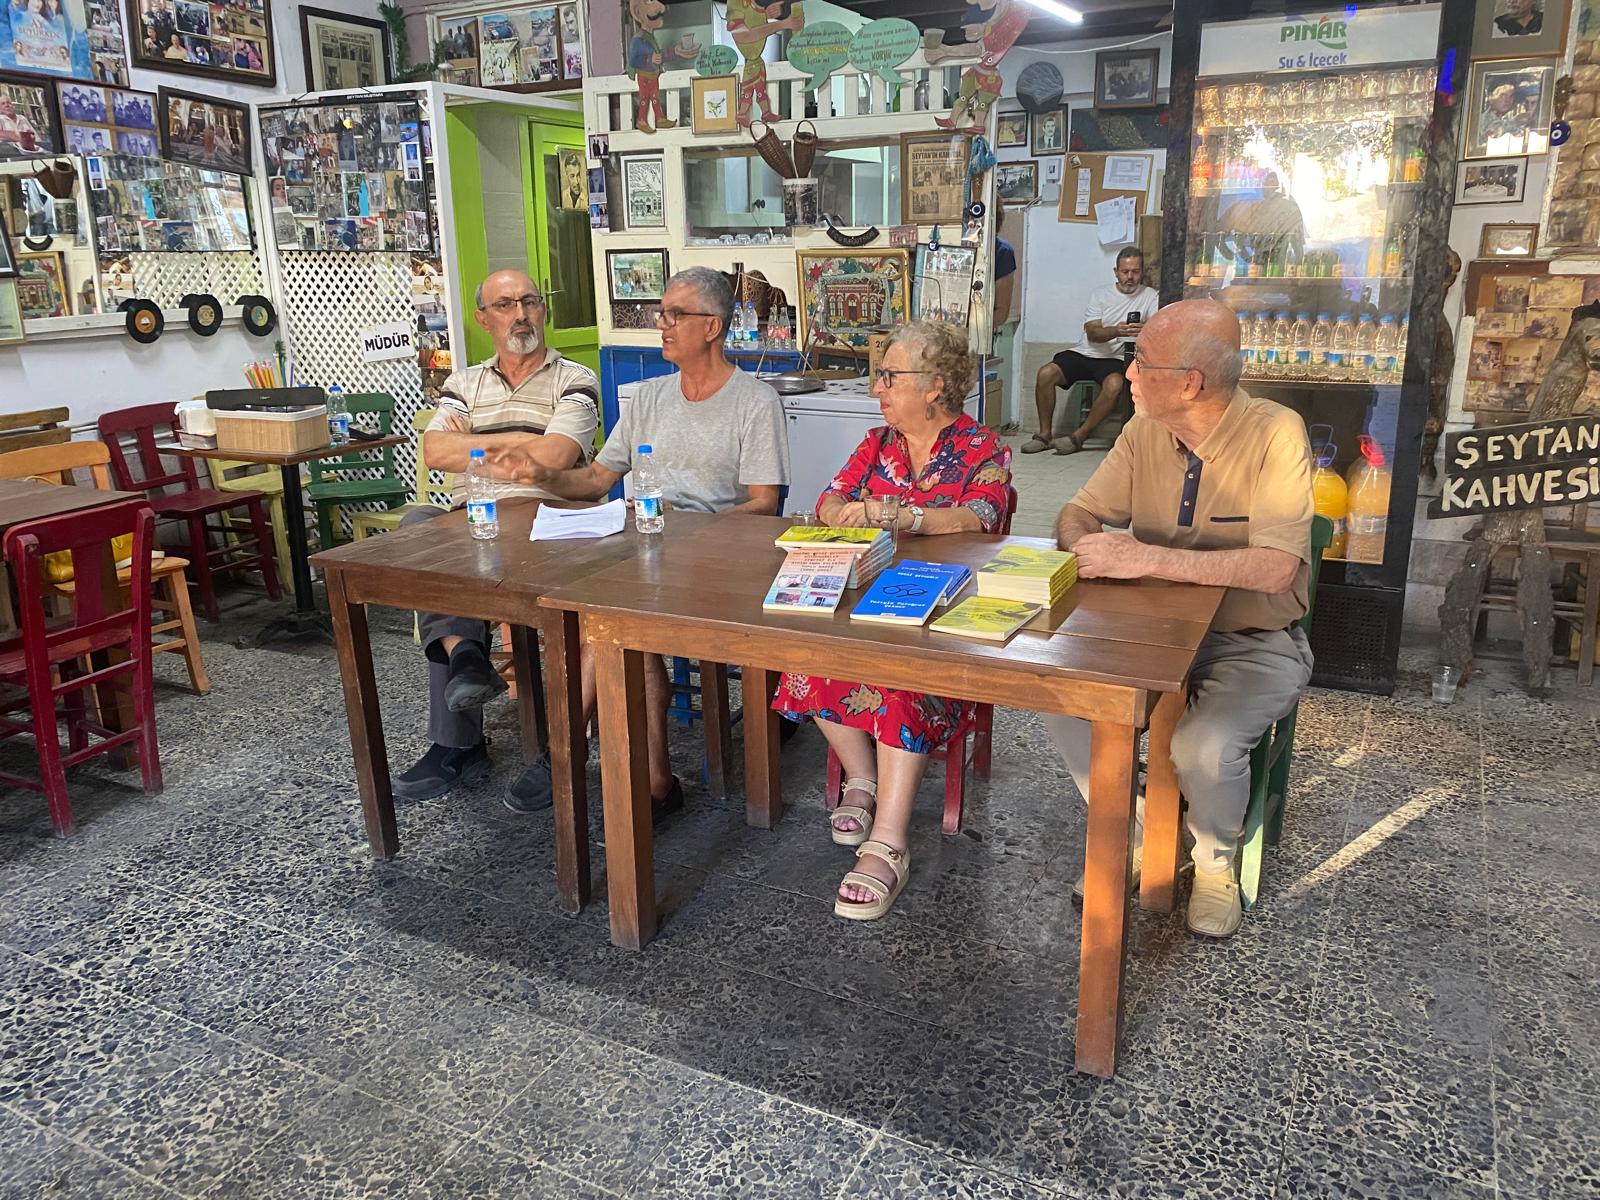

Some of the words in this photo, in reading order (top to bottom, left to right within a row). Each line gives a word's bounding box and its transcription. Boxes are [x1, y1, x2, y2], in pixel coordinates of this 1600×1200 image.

[1280, 20, 1347, 43] PINAR
[1279, 56, 1293, 69] Su
[1296, 55, 1305, 67] &
[1309, 52, 1348, 67] İçecek
[364, 332, 410, 352] MÜDÜR
[1454, 423, 1600, 470] ŞEYTAN
[1441, 457, 1600, 512] KAHVESİ
